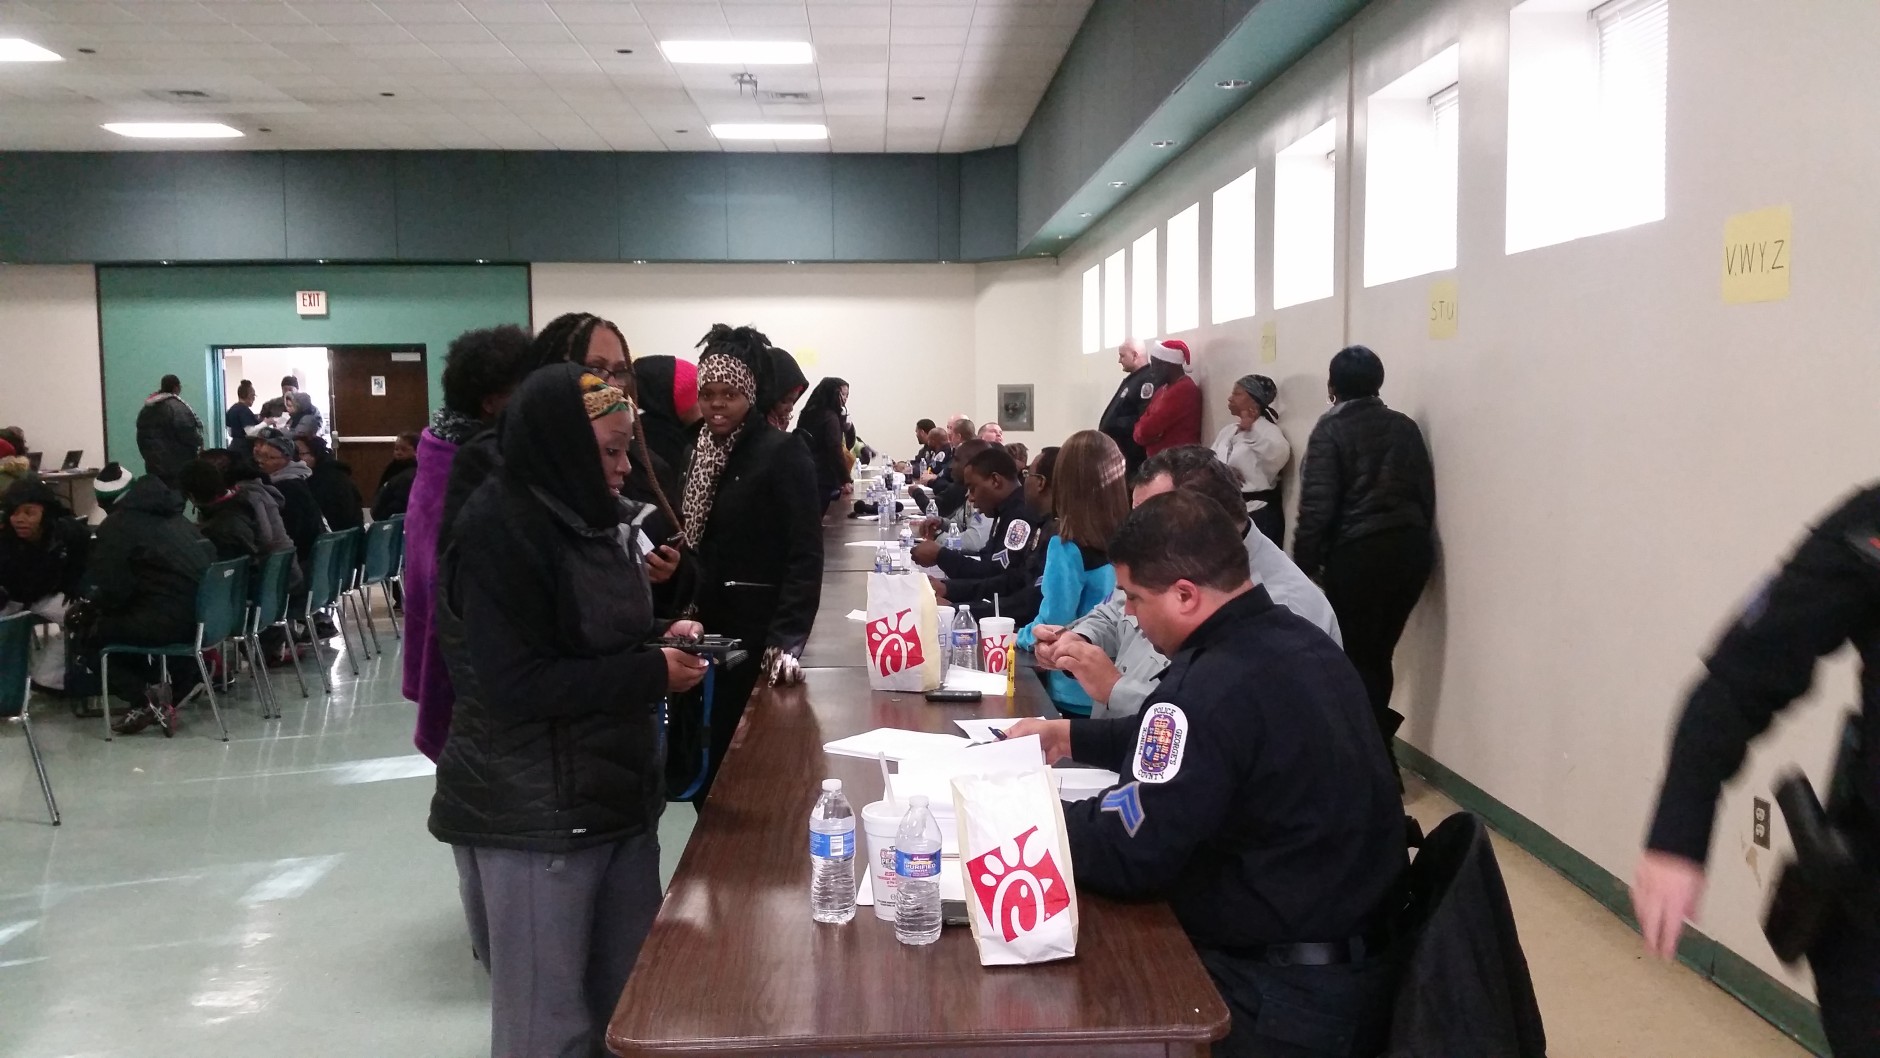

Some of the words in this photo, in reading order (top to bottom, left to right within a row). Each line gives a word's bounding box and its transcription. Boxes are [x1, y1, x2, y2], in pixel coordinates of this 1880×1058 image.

[302, 292, 320, 307] EXIT
[1430, 300, 1455, 321] STU
[1153, 706, 1177, 717] POLICE
[1137, 769, 1165, 780] COUNTY
[905, 862, 936, 870] PURIFIED
